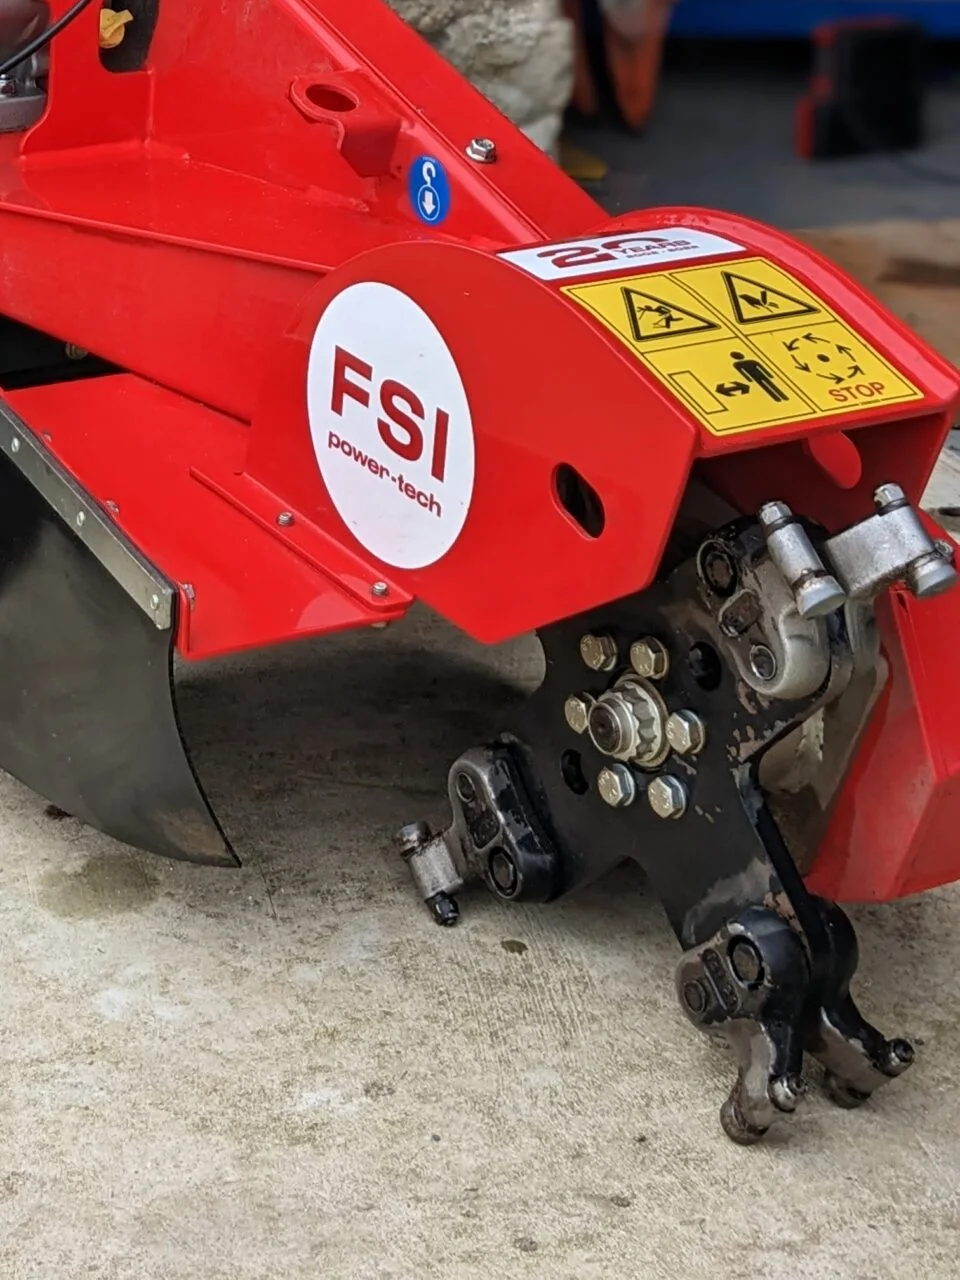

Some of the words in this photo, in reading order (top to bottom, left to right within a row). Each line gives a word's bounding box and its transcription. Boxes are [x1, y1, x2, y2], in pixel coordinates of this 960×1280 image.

[614, 239, 692, 255] YEARS
[331, 345, 449, 483] FSI
[828, 381, 885, 402] STOP
[328, 430, 442, 517] power-tech
